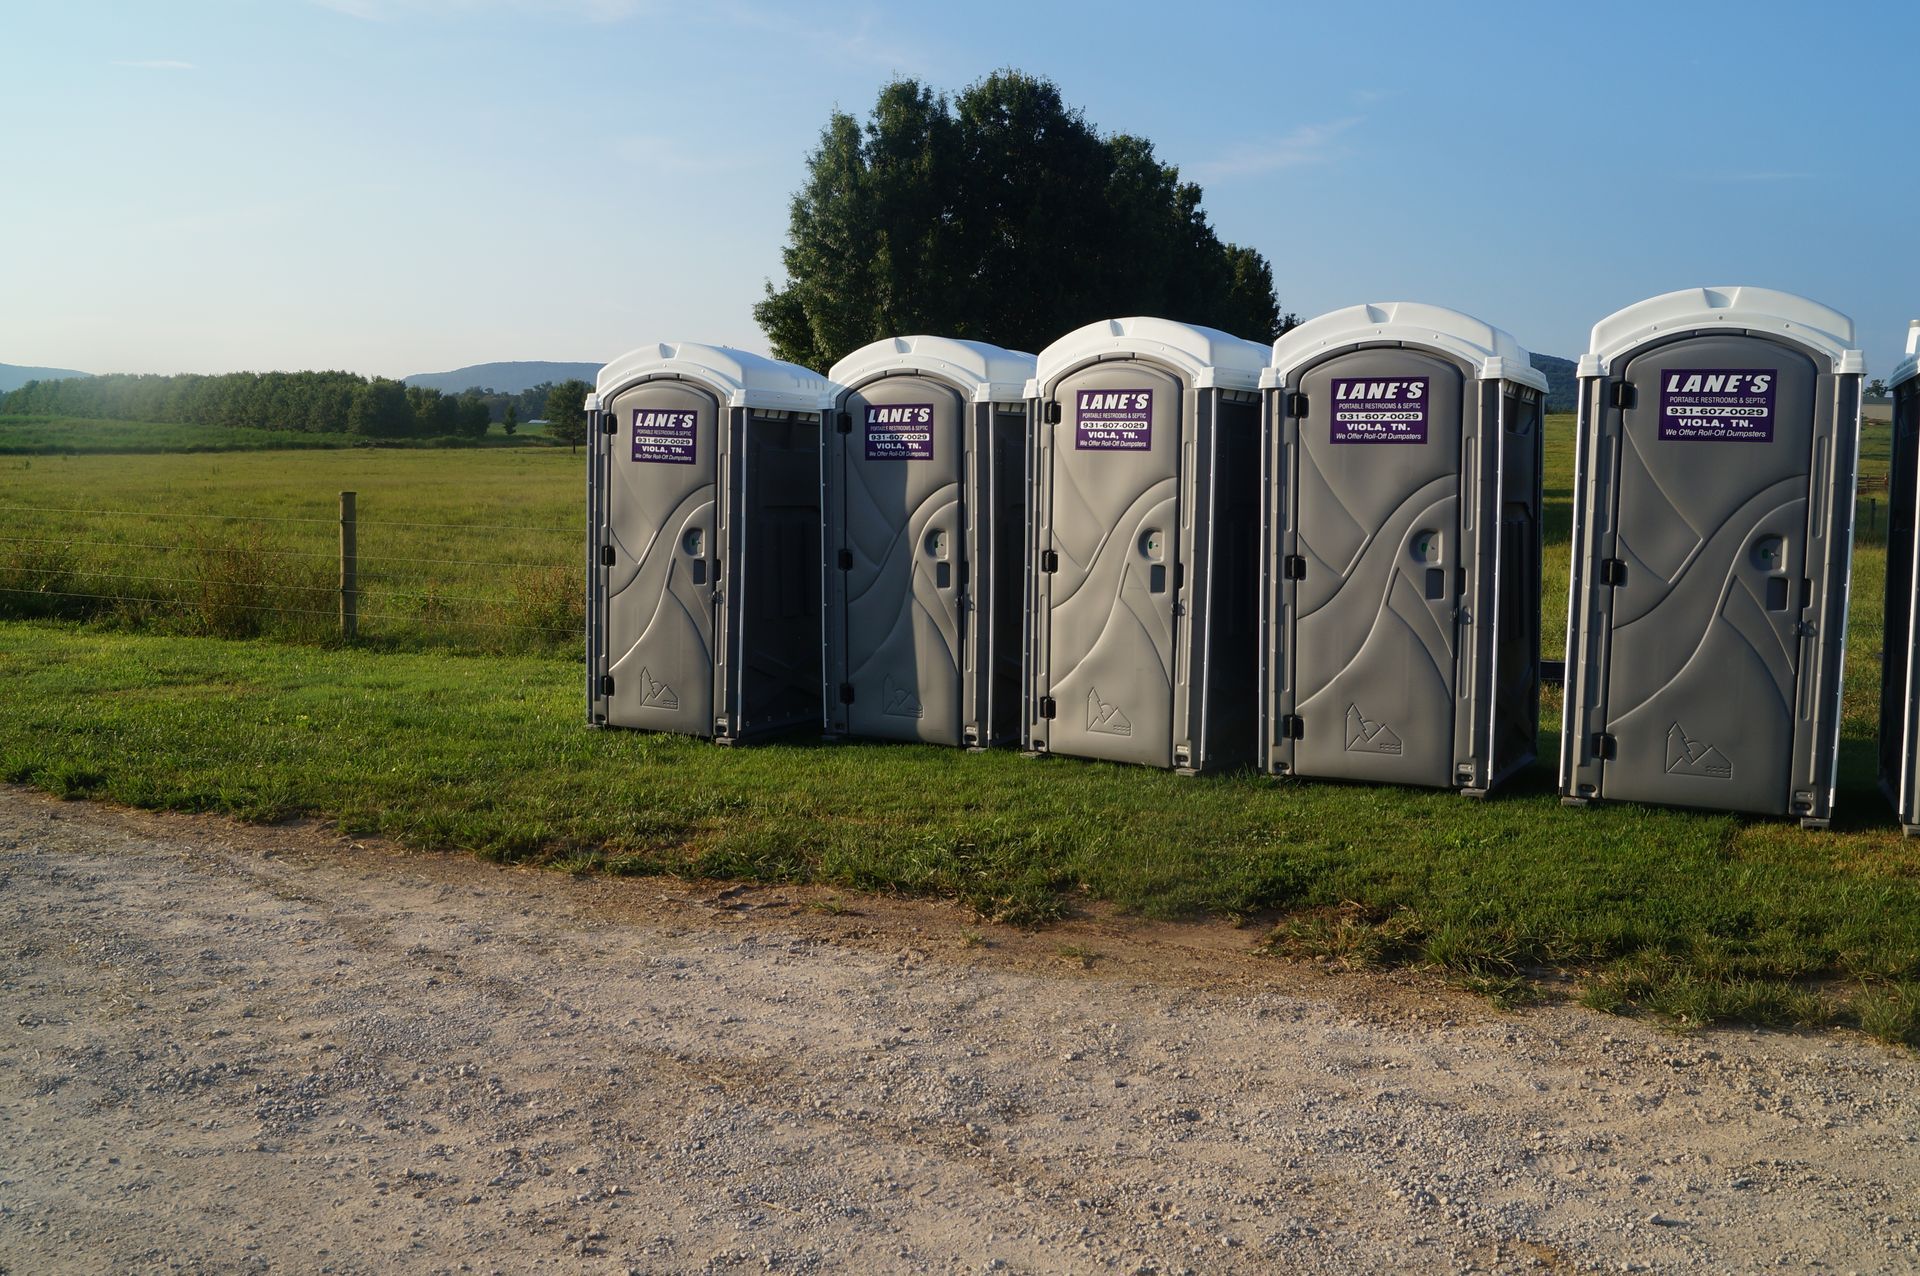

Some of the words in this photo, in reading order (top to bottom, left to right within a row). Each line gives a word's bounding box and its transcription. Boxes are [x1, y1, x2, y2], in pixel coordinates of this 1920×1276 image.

[1336, 382, 1424, 399] LANE'S
[1667, 375, 1771, 393] LANE'S
[1080, 394, 1149, 409] LANE'S
[636, 413, 694, 428] LANE'S
[868, 408, 930, 423] LANE'S
[1679, 419, 1724, 428] VIOLA,
[1727, 430, 1766, 438] Dumpsters
